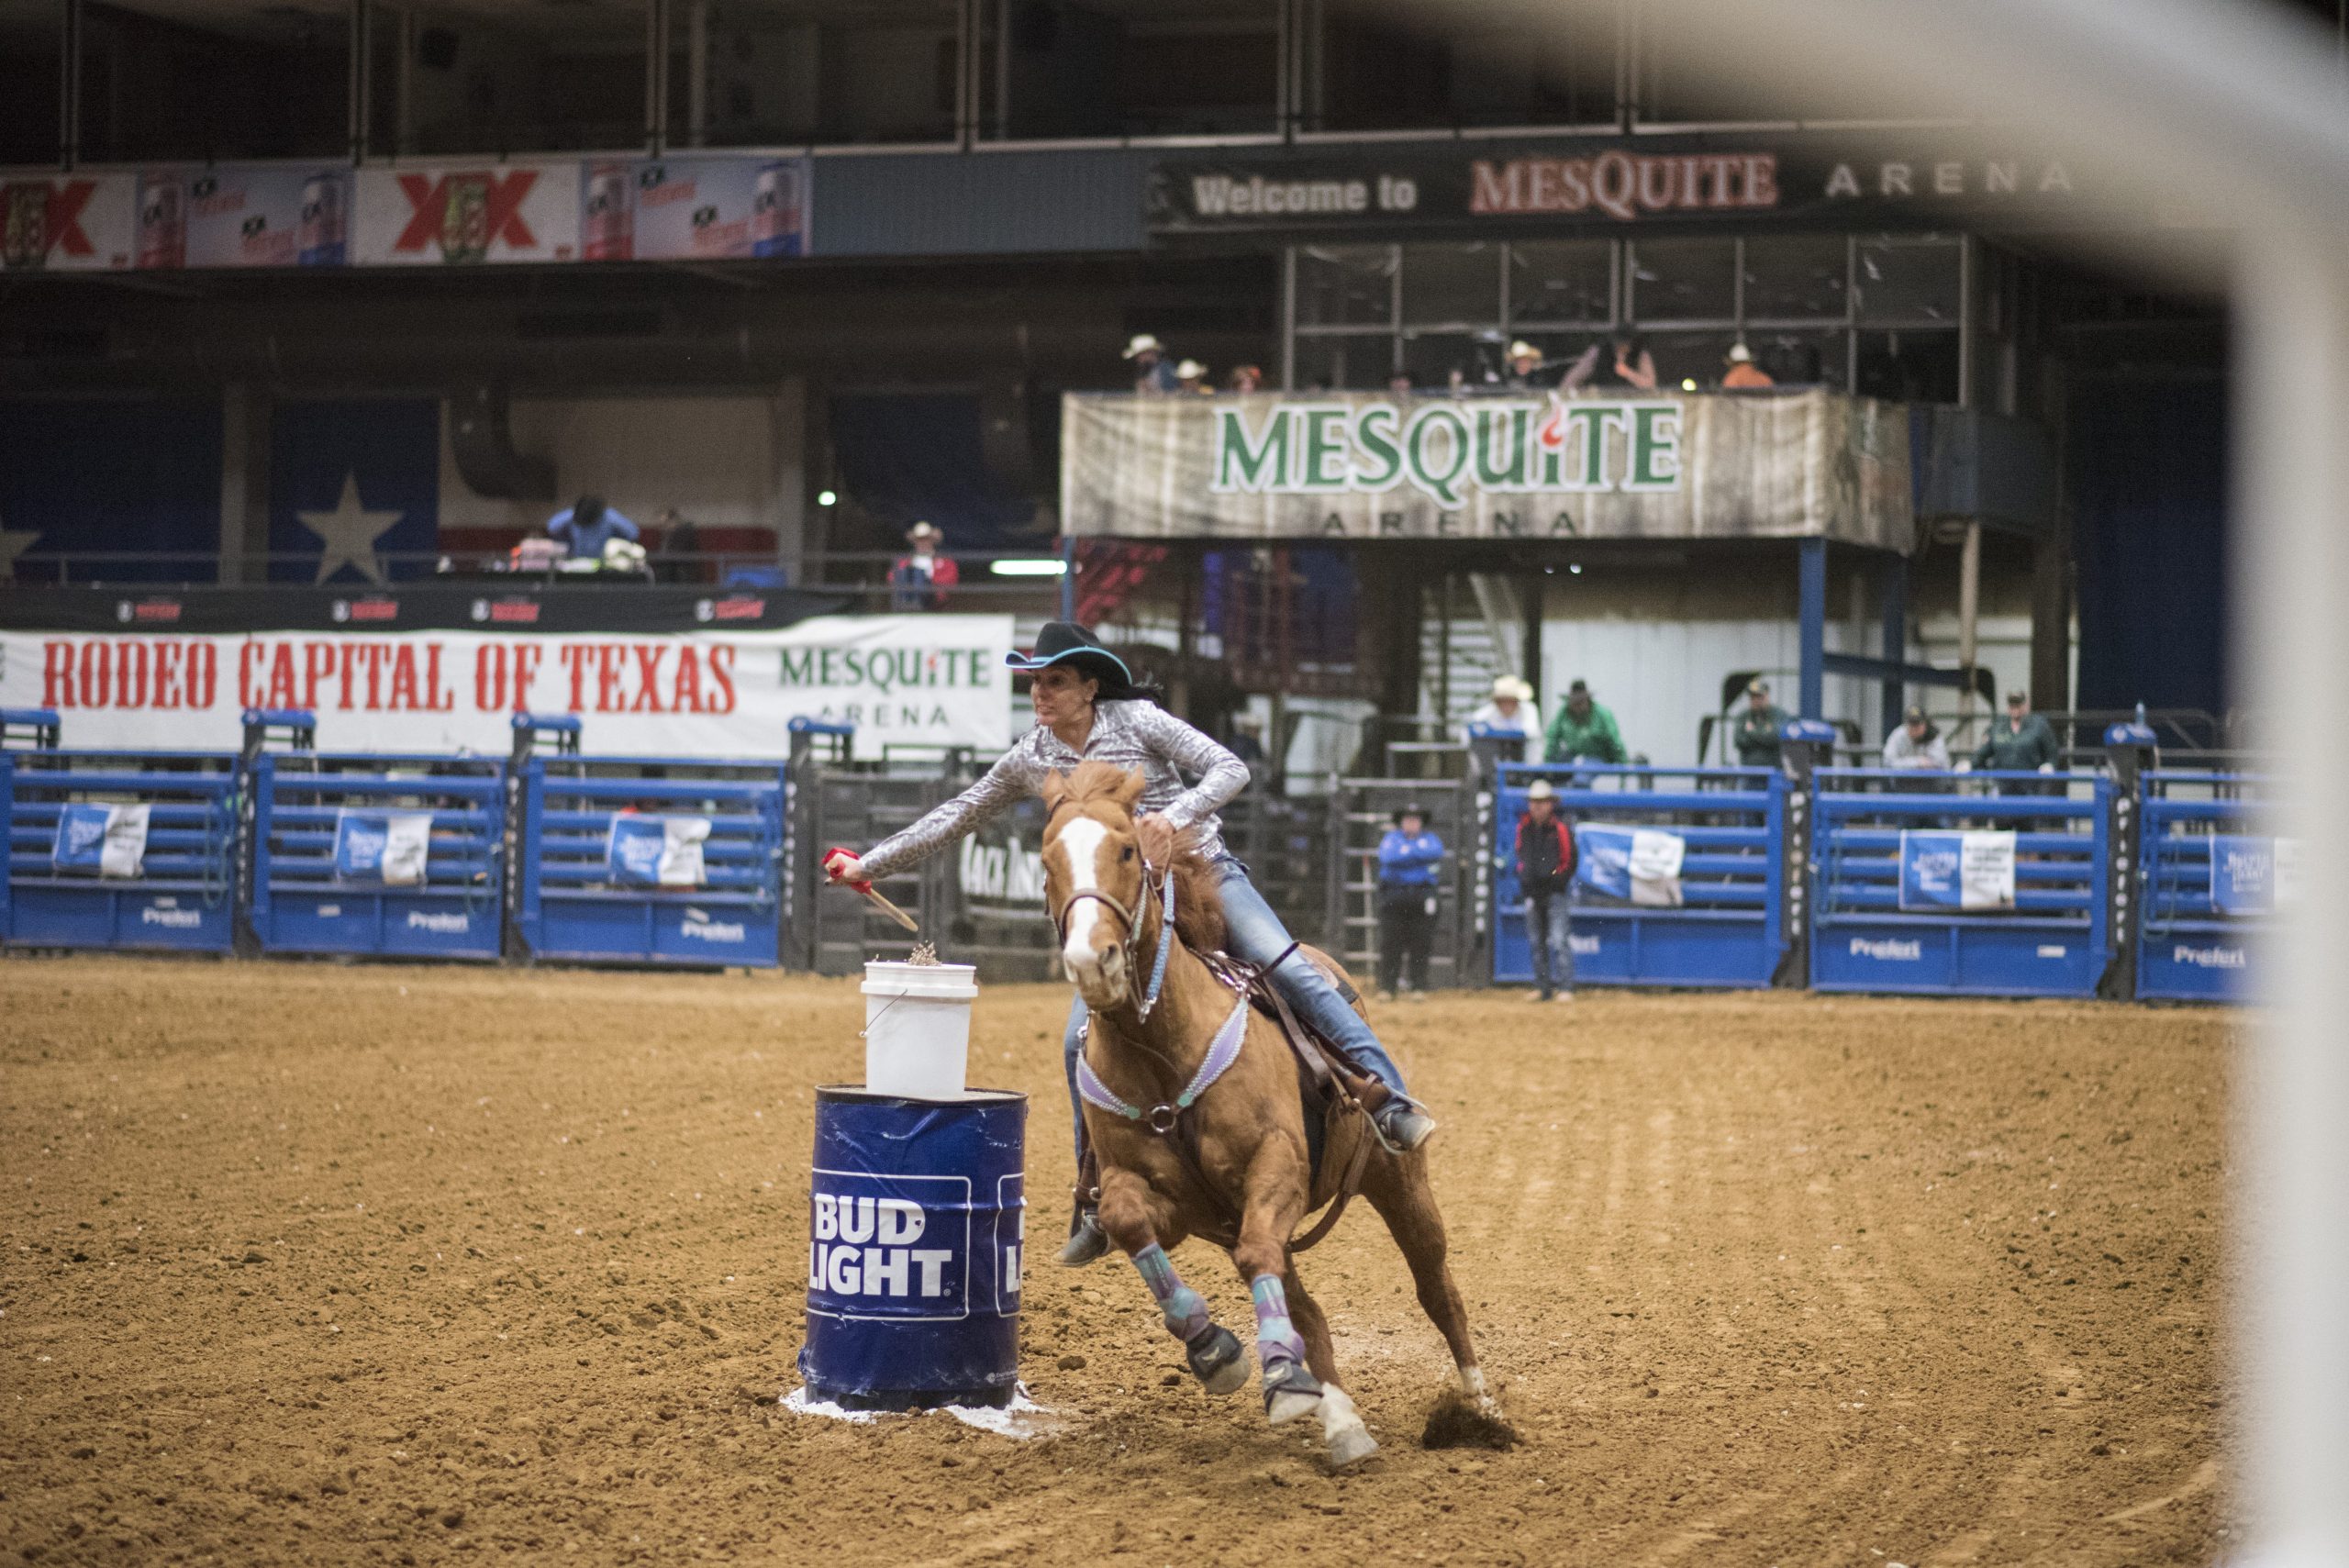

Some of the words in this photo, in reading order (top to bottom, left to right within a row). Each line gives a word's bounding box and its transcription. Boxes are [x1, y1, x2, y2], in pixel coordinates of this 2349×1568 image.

[1194, 175, 1369, 214] Welcome
[1378, 173, 1418, 211] to
[1470, 150, 1779, 220] MESQUITE
[1825, 161, 2071, 196] ARENA
[1324, 511, 1576, 537] ARENA
[42, 641, 217, 709] RODEO
[239, 641, 453, 711] CAPITAL
[475, 643, 541, 713] OF
[561, 643, 737, 715] TEXAS
[815, 1193, 926, 1245] BUD
[809, 1241, 952, 1296] LIGHT
